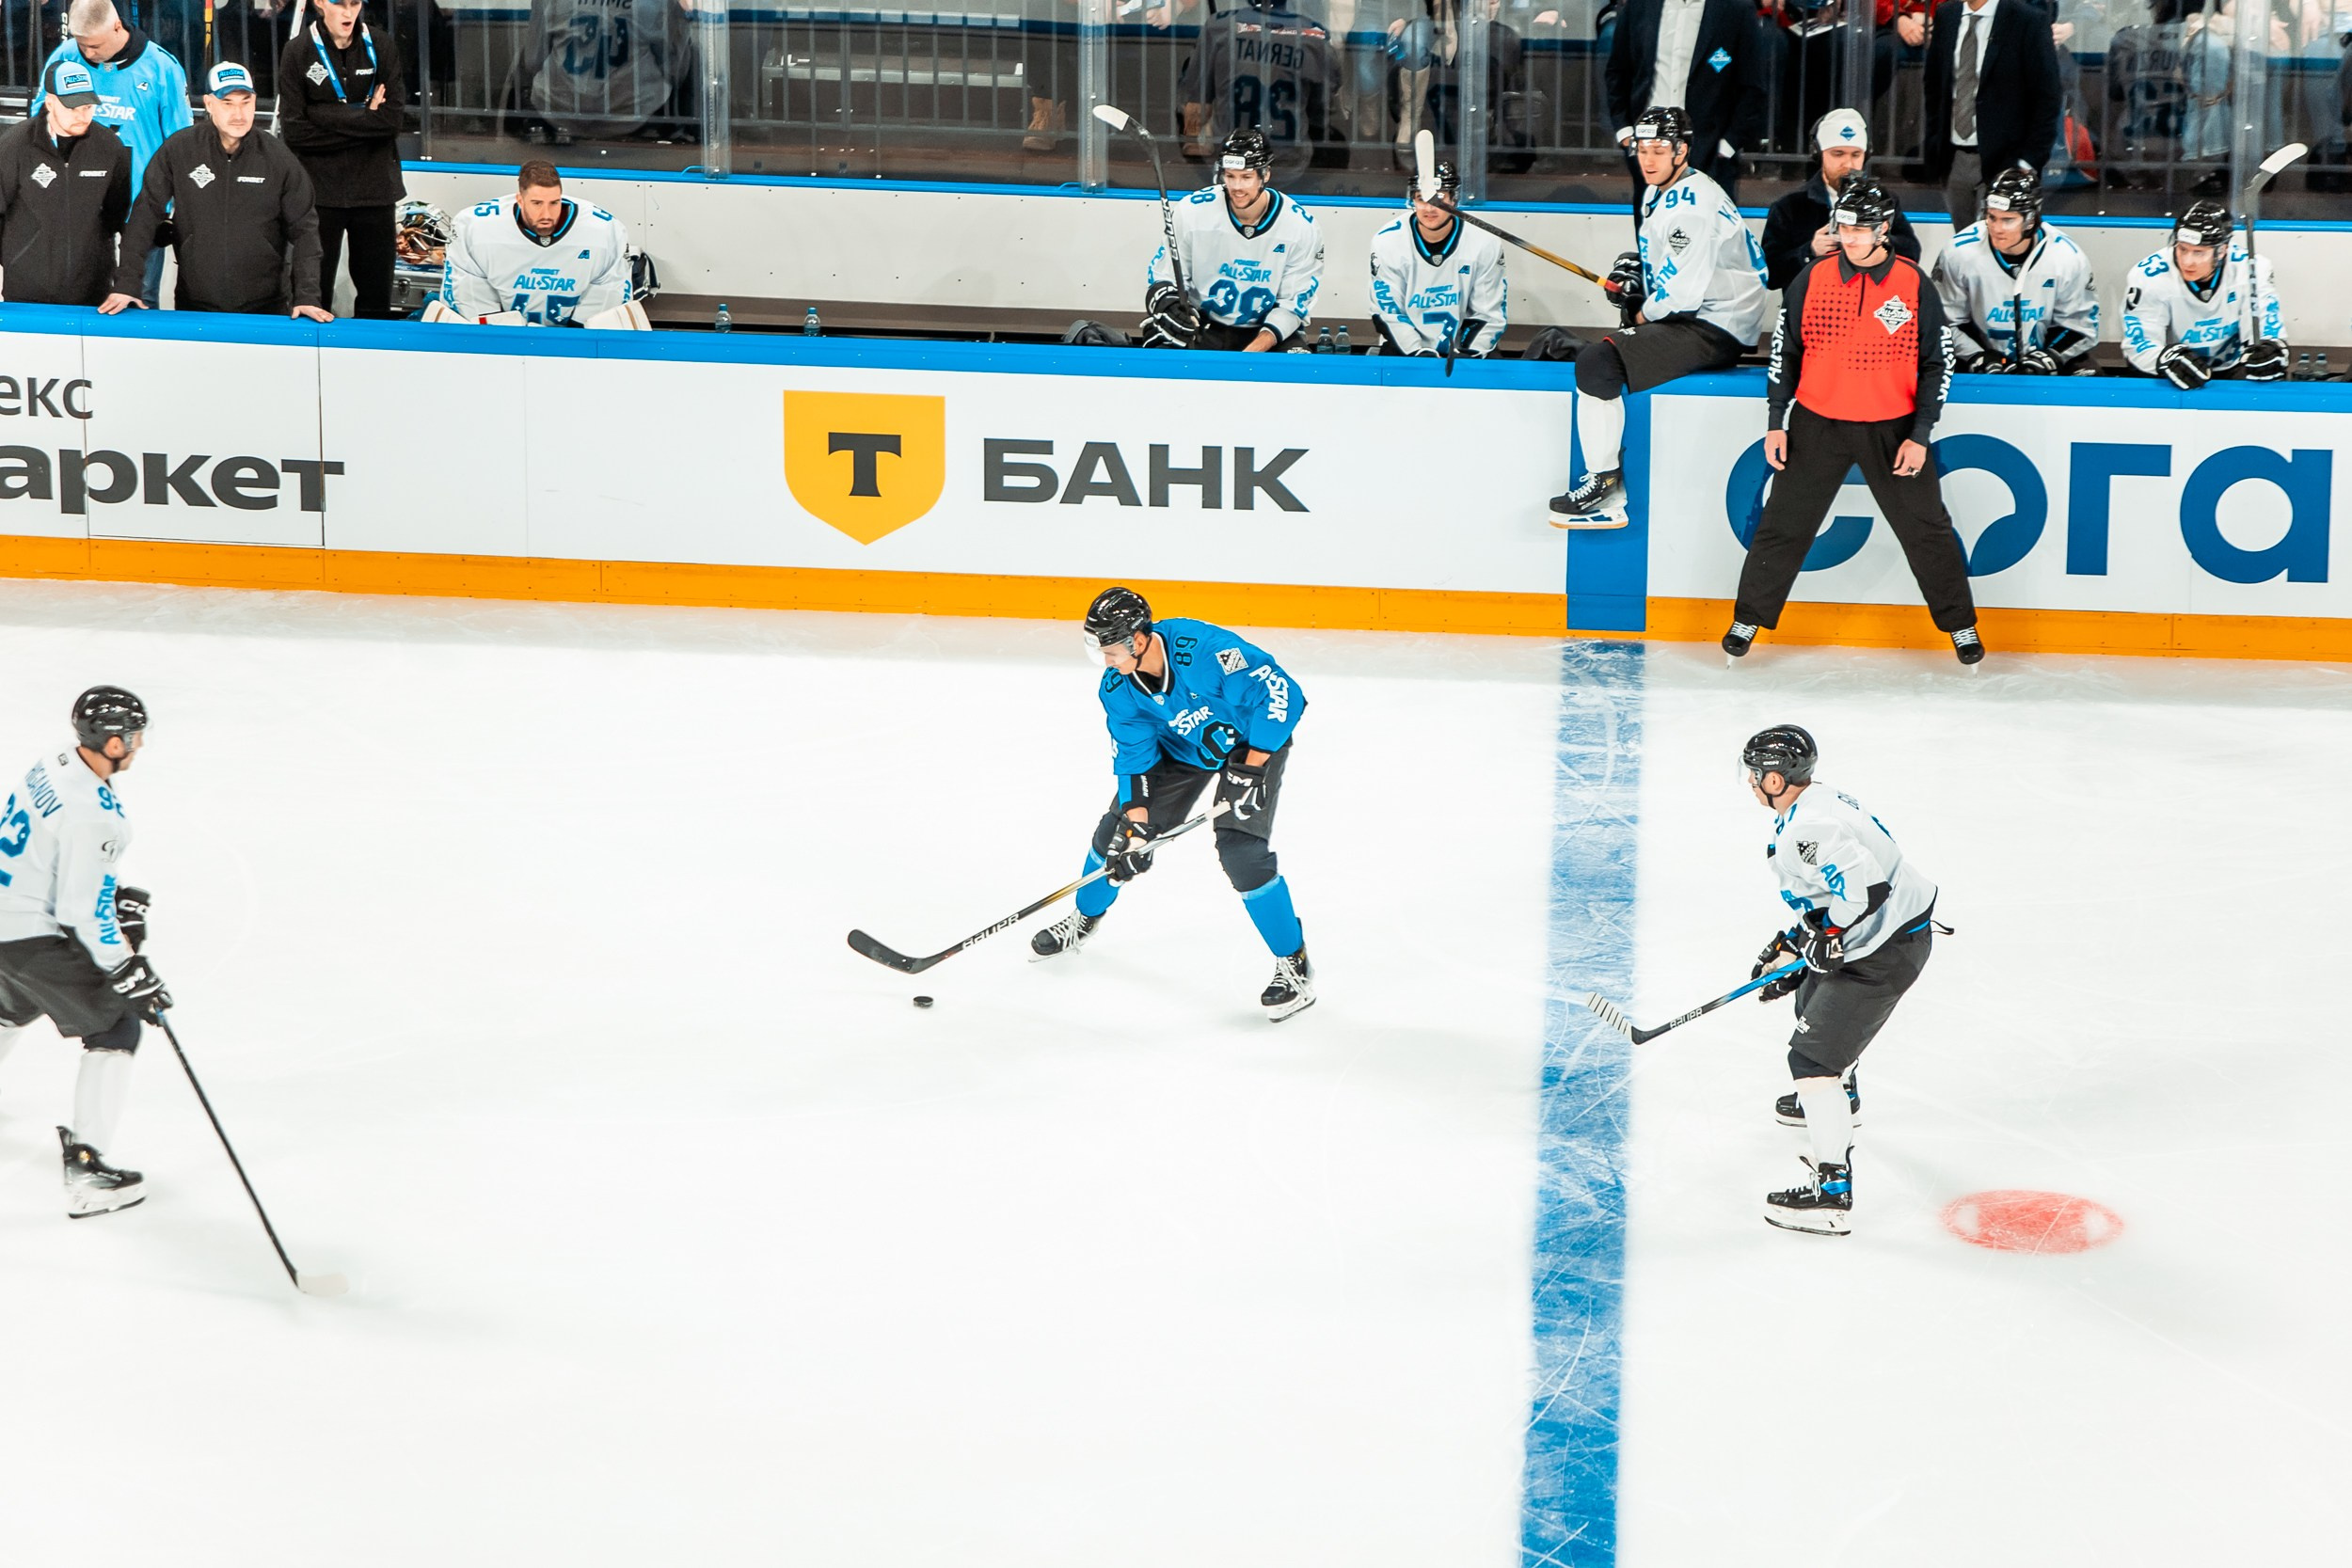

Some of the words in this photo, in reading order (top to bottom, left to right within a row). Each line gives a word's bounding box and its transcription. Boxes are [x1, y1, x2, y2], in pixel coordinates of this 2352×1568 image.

[1665, 187, 1696, 209] 94
[984, 437, 1311, 513] БАНК
[1176, 635, 1199, 668] 89
[961, 912, 1020, 950] BAUER
[1669, 1007, 1703, 1030] BAUER
